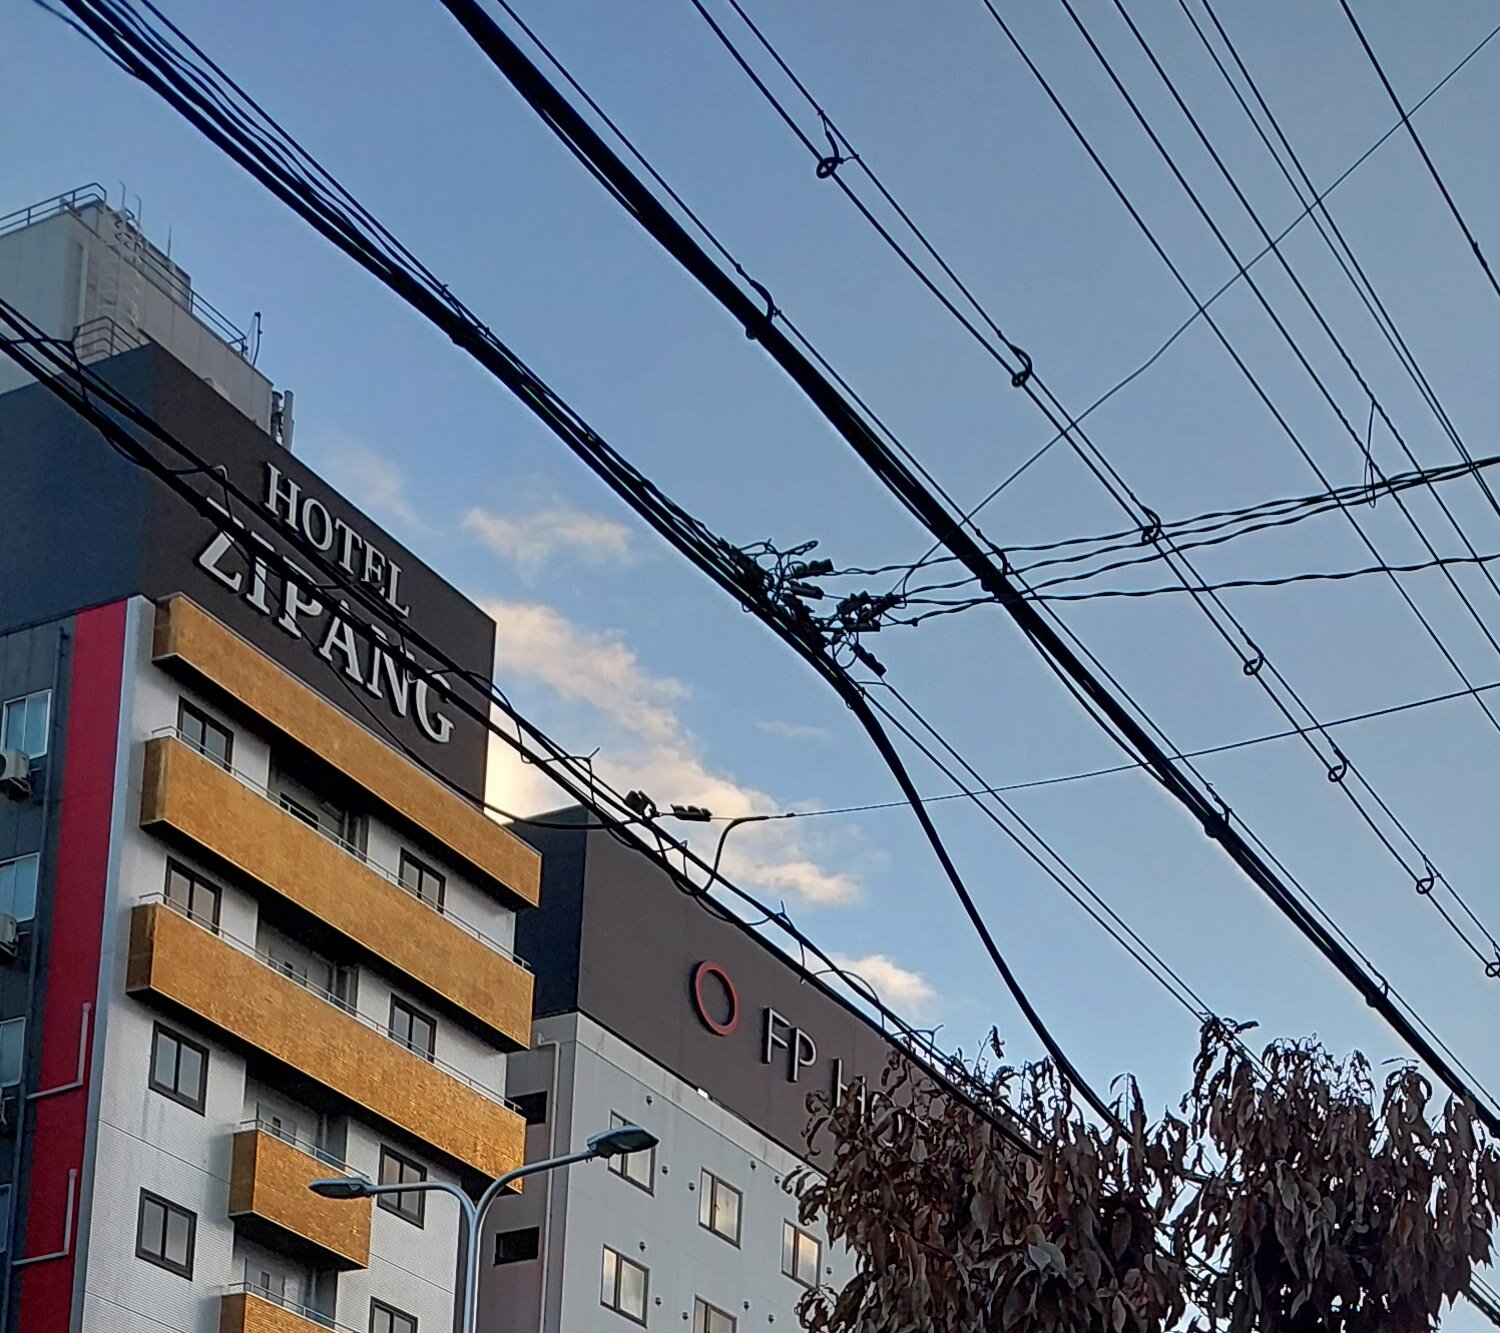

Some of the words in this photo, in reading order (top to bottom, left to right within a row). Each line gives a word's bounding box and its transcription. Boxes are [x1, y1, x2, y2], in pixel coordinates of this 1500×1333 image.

[264, 461, 410, 618] HOTEL
[199, 496, 455, 744] ZIPANG
[761, 1007, 818, 1084] FP
